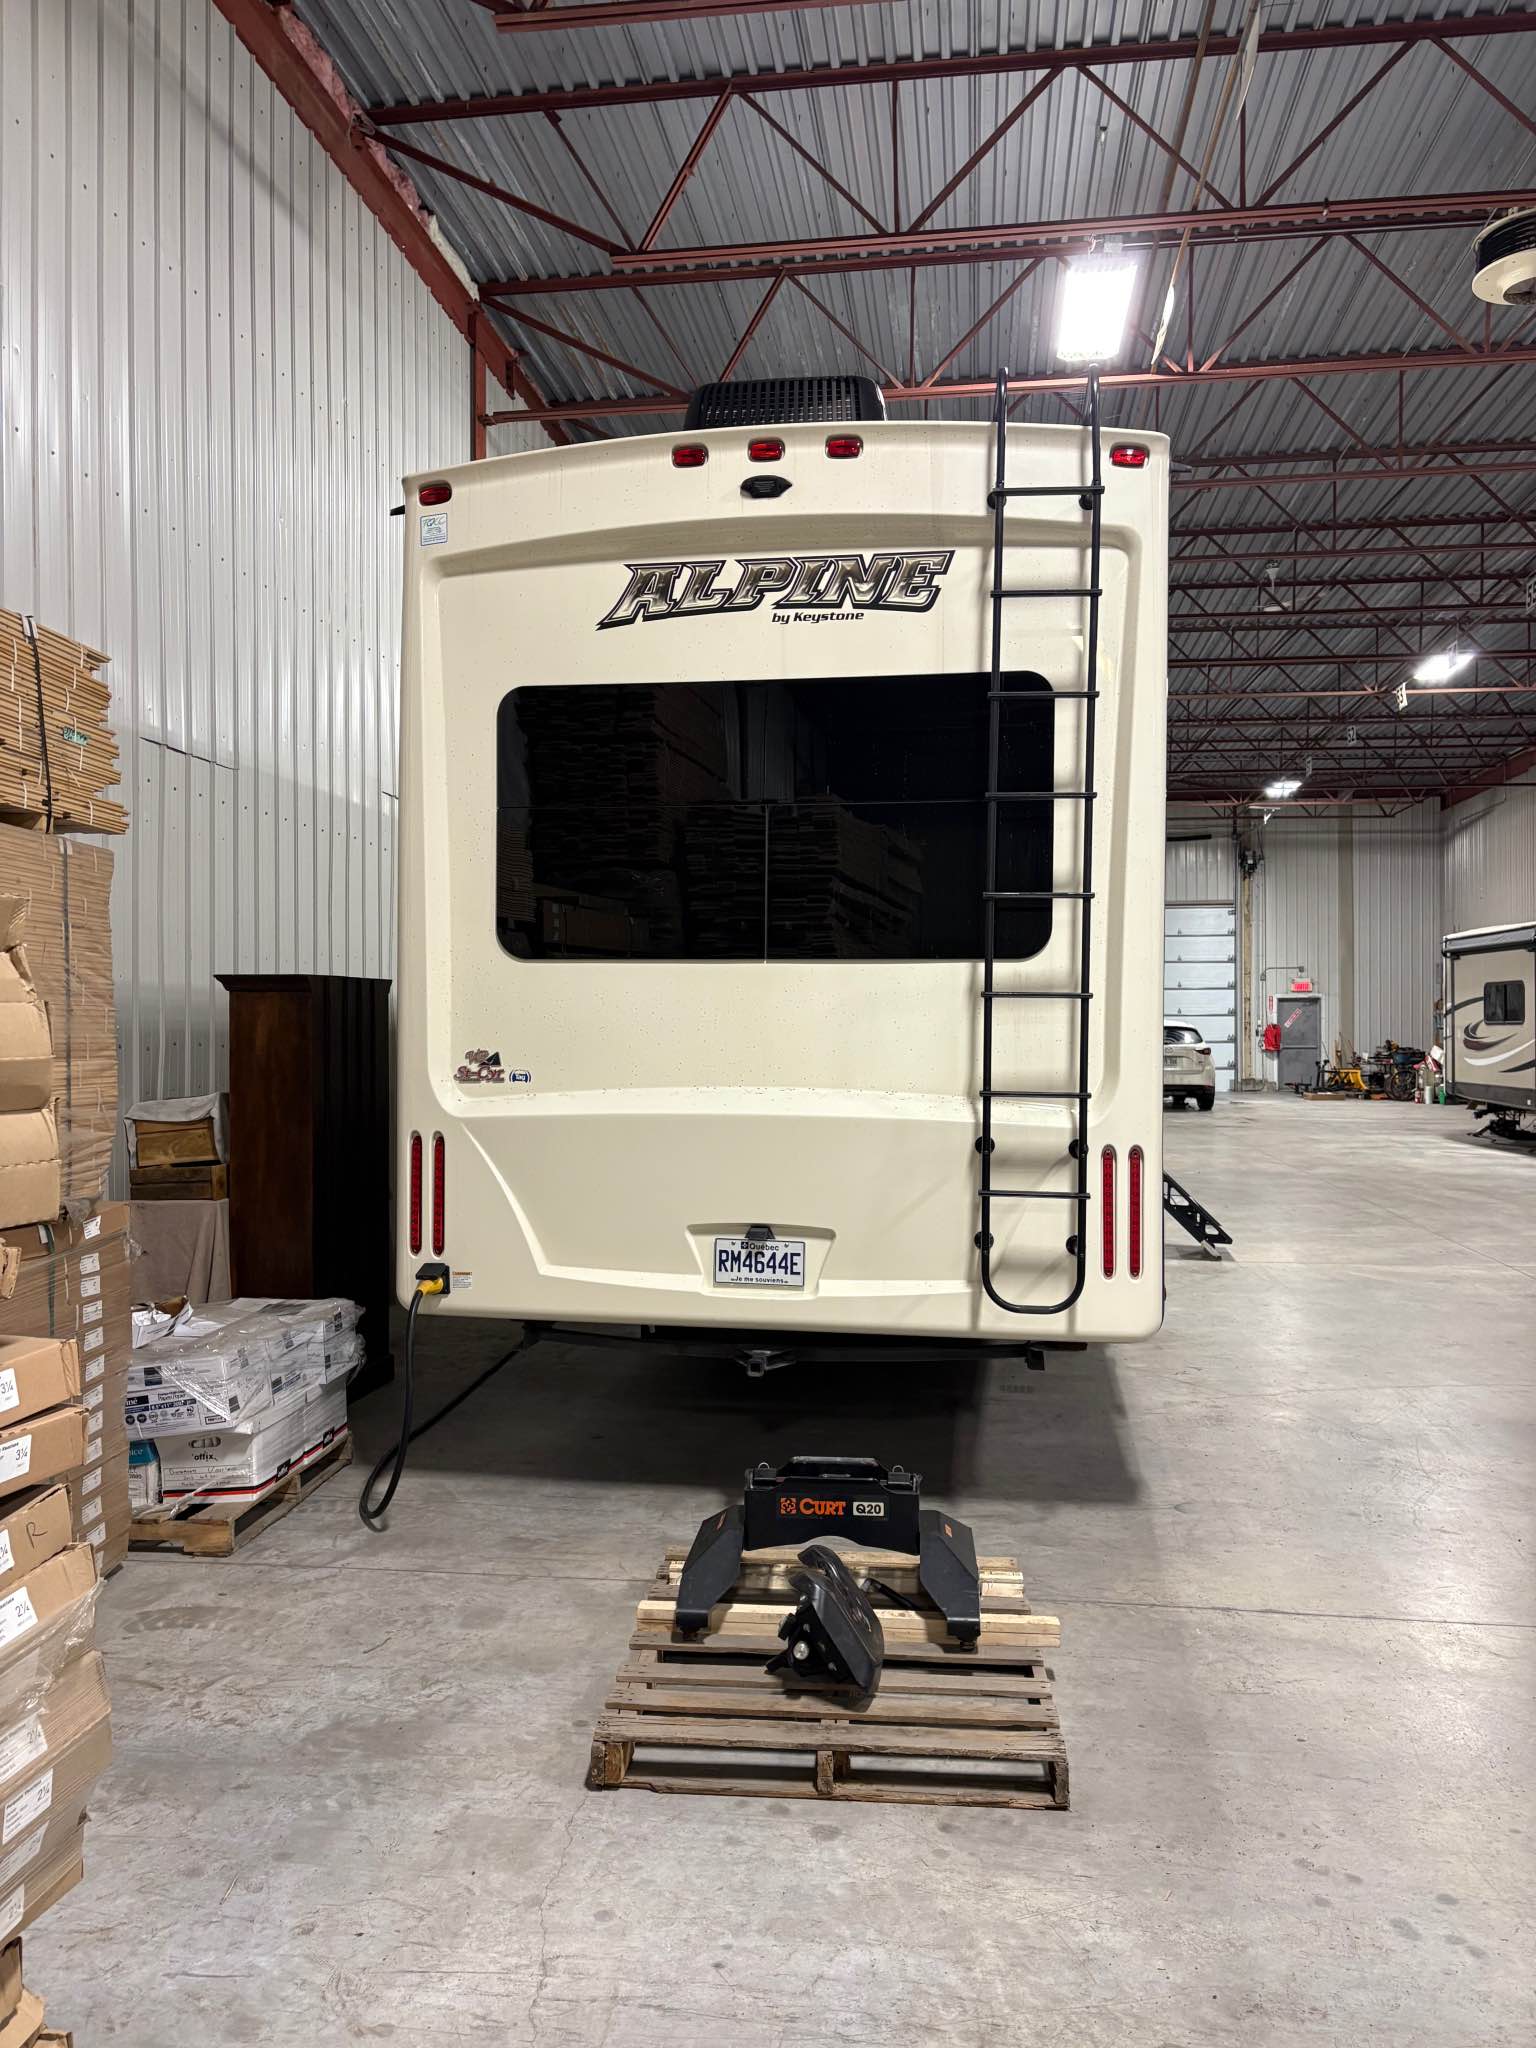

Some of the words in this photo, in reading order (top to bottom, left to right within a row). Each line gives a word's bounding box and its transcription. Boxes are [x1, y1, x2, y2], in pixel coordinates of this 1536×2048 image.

[595, 550, 955, 631] ALPINE
[771, 611, 789, 624] by
[793, 611, 864, 624] Keystone
[749, 1242, 780, 1251] Québec
[718, 1249, 801, 1275] RM4644E
[799, 1497, 847, 1516] CURT
[855, 1503, 882, 1515] Q20
[26, 1521, 48, 1549] R
